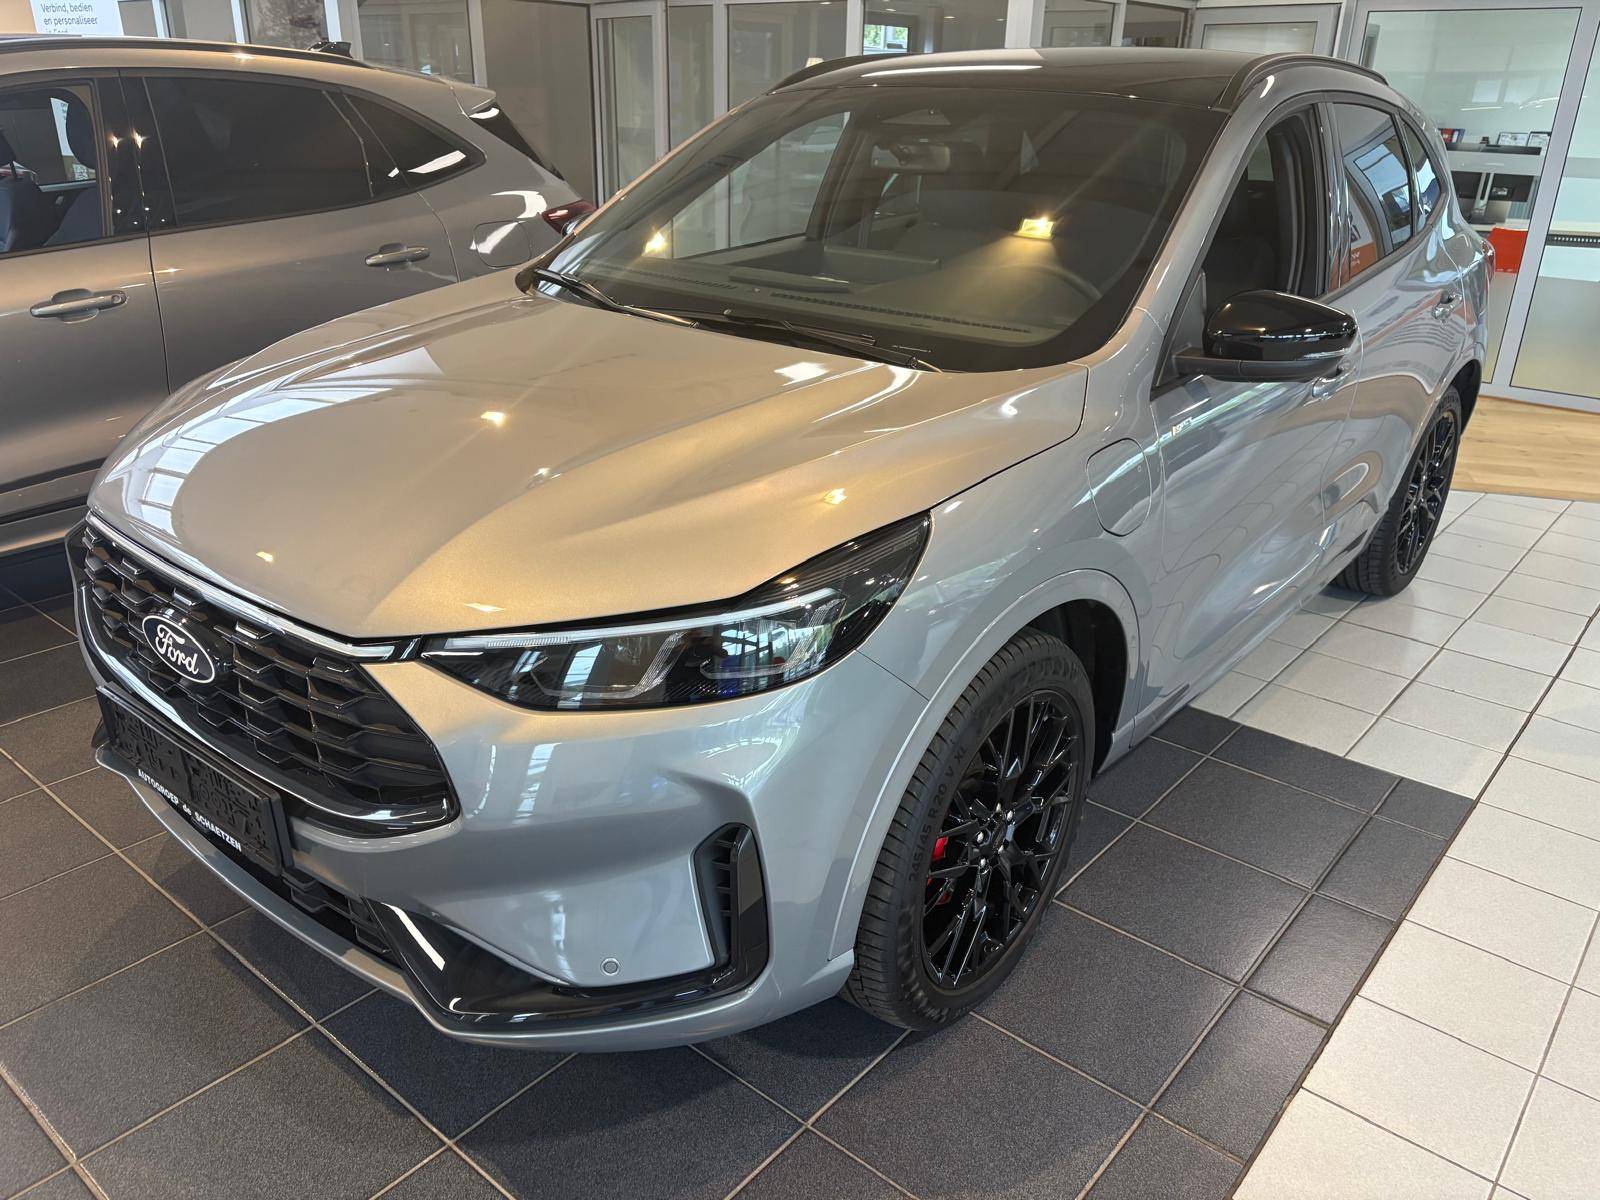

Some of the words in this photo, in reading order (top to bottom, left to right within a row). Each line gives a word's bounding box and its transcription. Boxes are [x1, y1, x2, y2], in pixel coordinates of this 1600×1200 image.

[40, 3, 69, 14] Verbind,
[69, 2, 93, 12] bedien
[53, 16, 98, 26] personaliseer
[155, 624, 199, 675] Ford
[137, 768, 179, 805] AUTOGROEP
[182, 803, 192, 816] de
[194, 811, 242, 852] SCHAETZEN
[928, 807, 938, 819] R
[934, 783, 947, 807] 20
